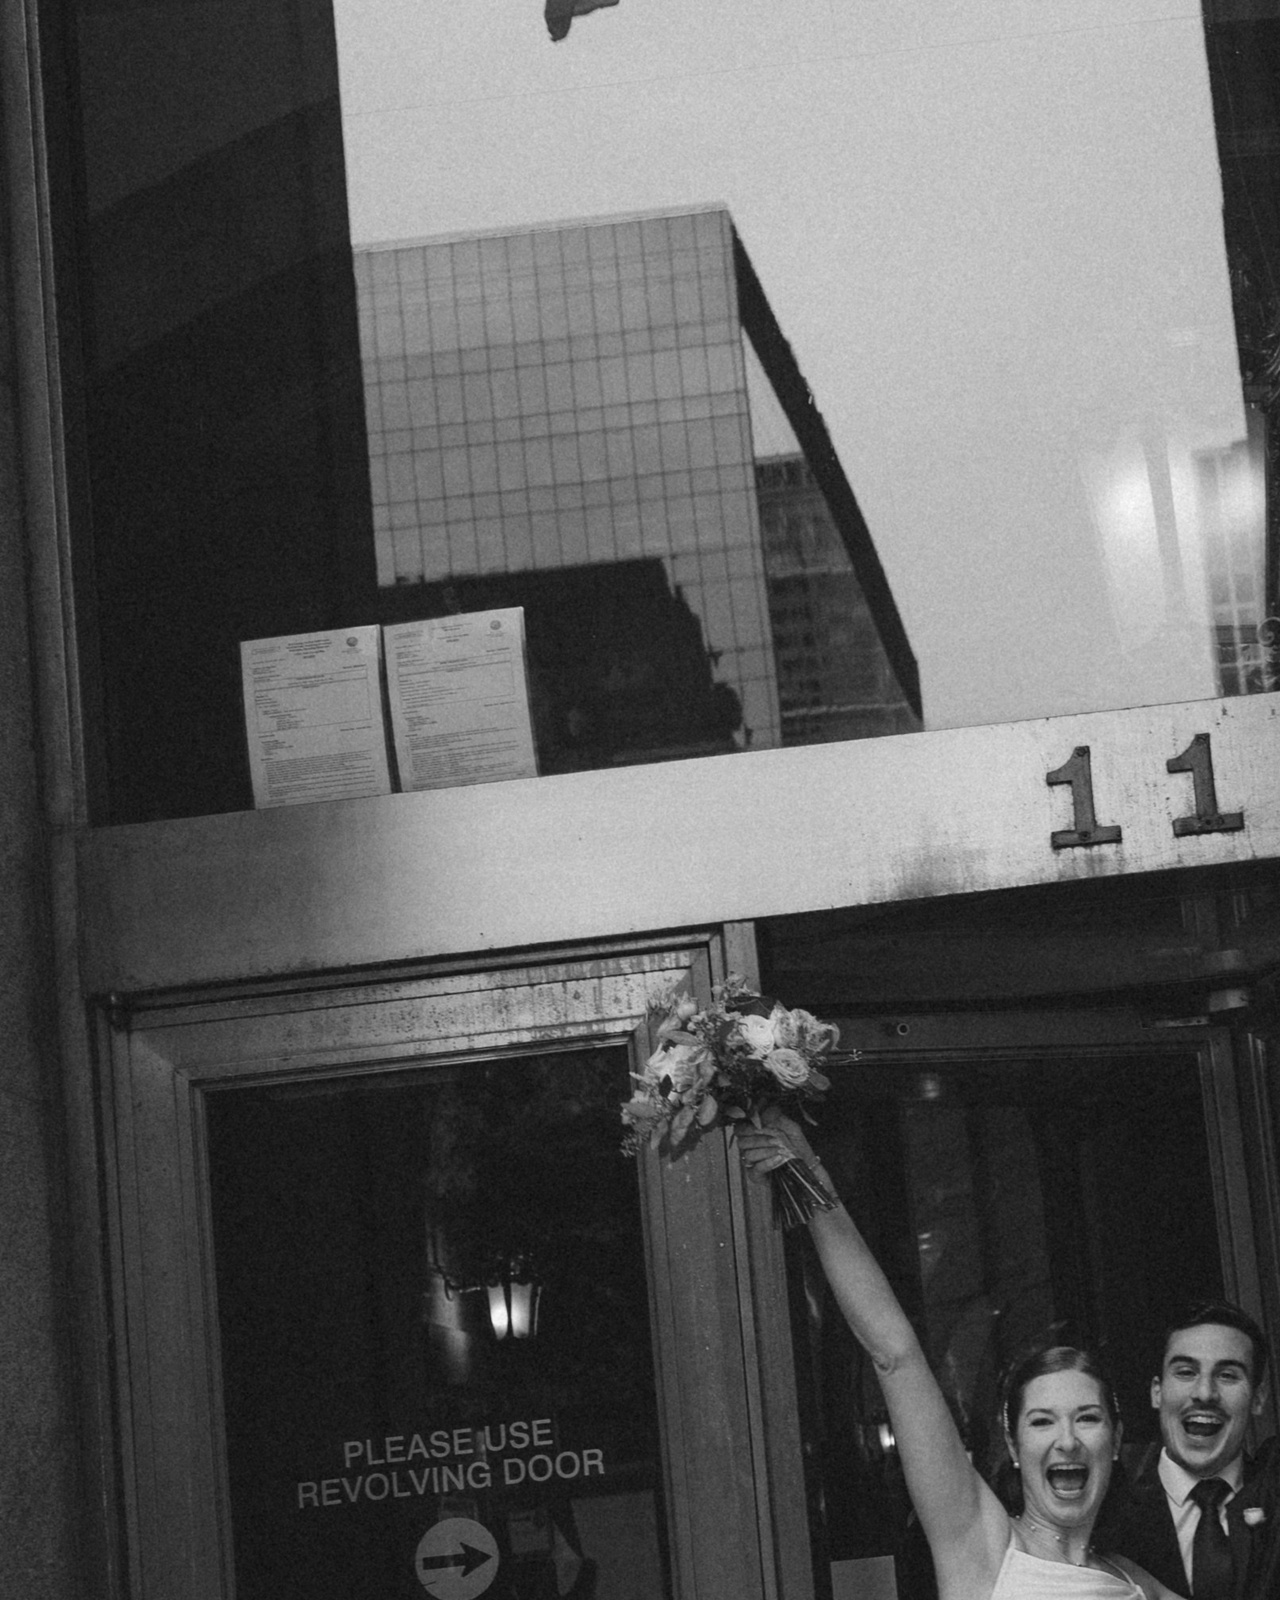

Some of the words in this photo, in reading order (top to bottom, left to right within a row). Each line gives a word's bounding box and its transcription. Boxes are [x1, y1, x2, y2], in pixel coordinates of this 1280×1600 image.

[343, 1427, 474, 1468] PLEASE
[484, 1418, 553, 1452] USE
[297, 1462, 492, 1509] REVOLVING
[503, 1449, 605, 1485] DOOR
